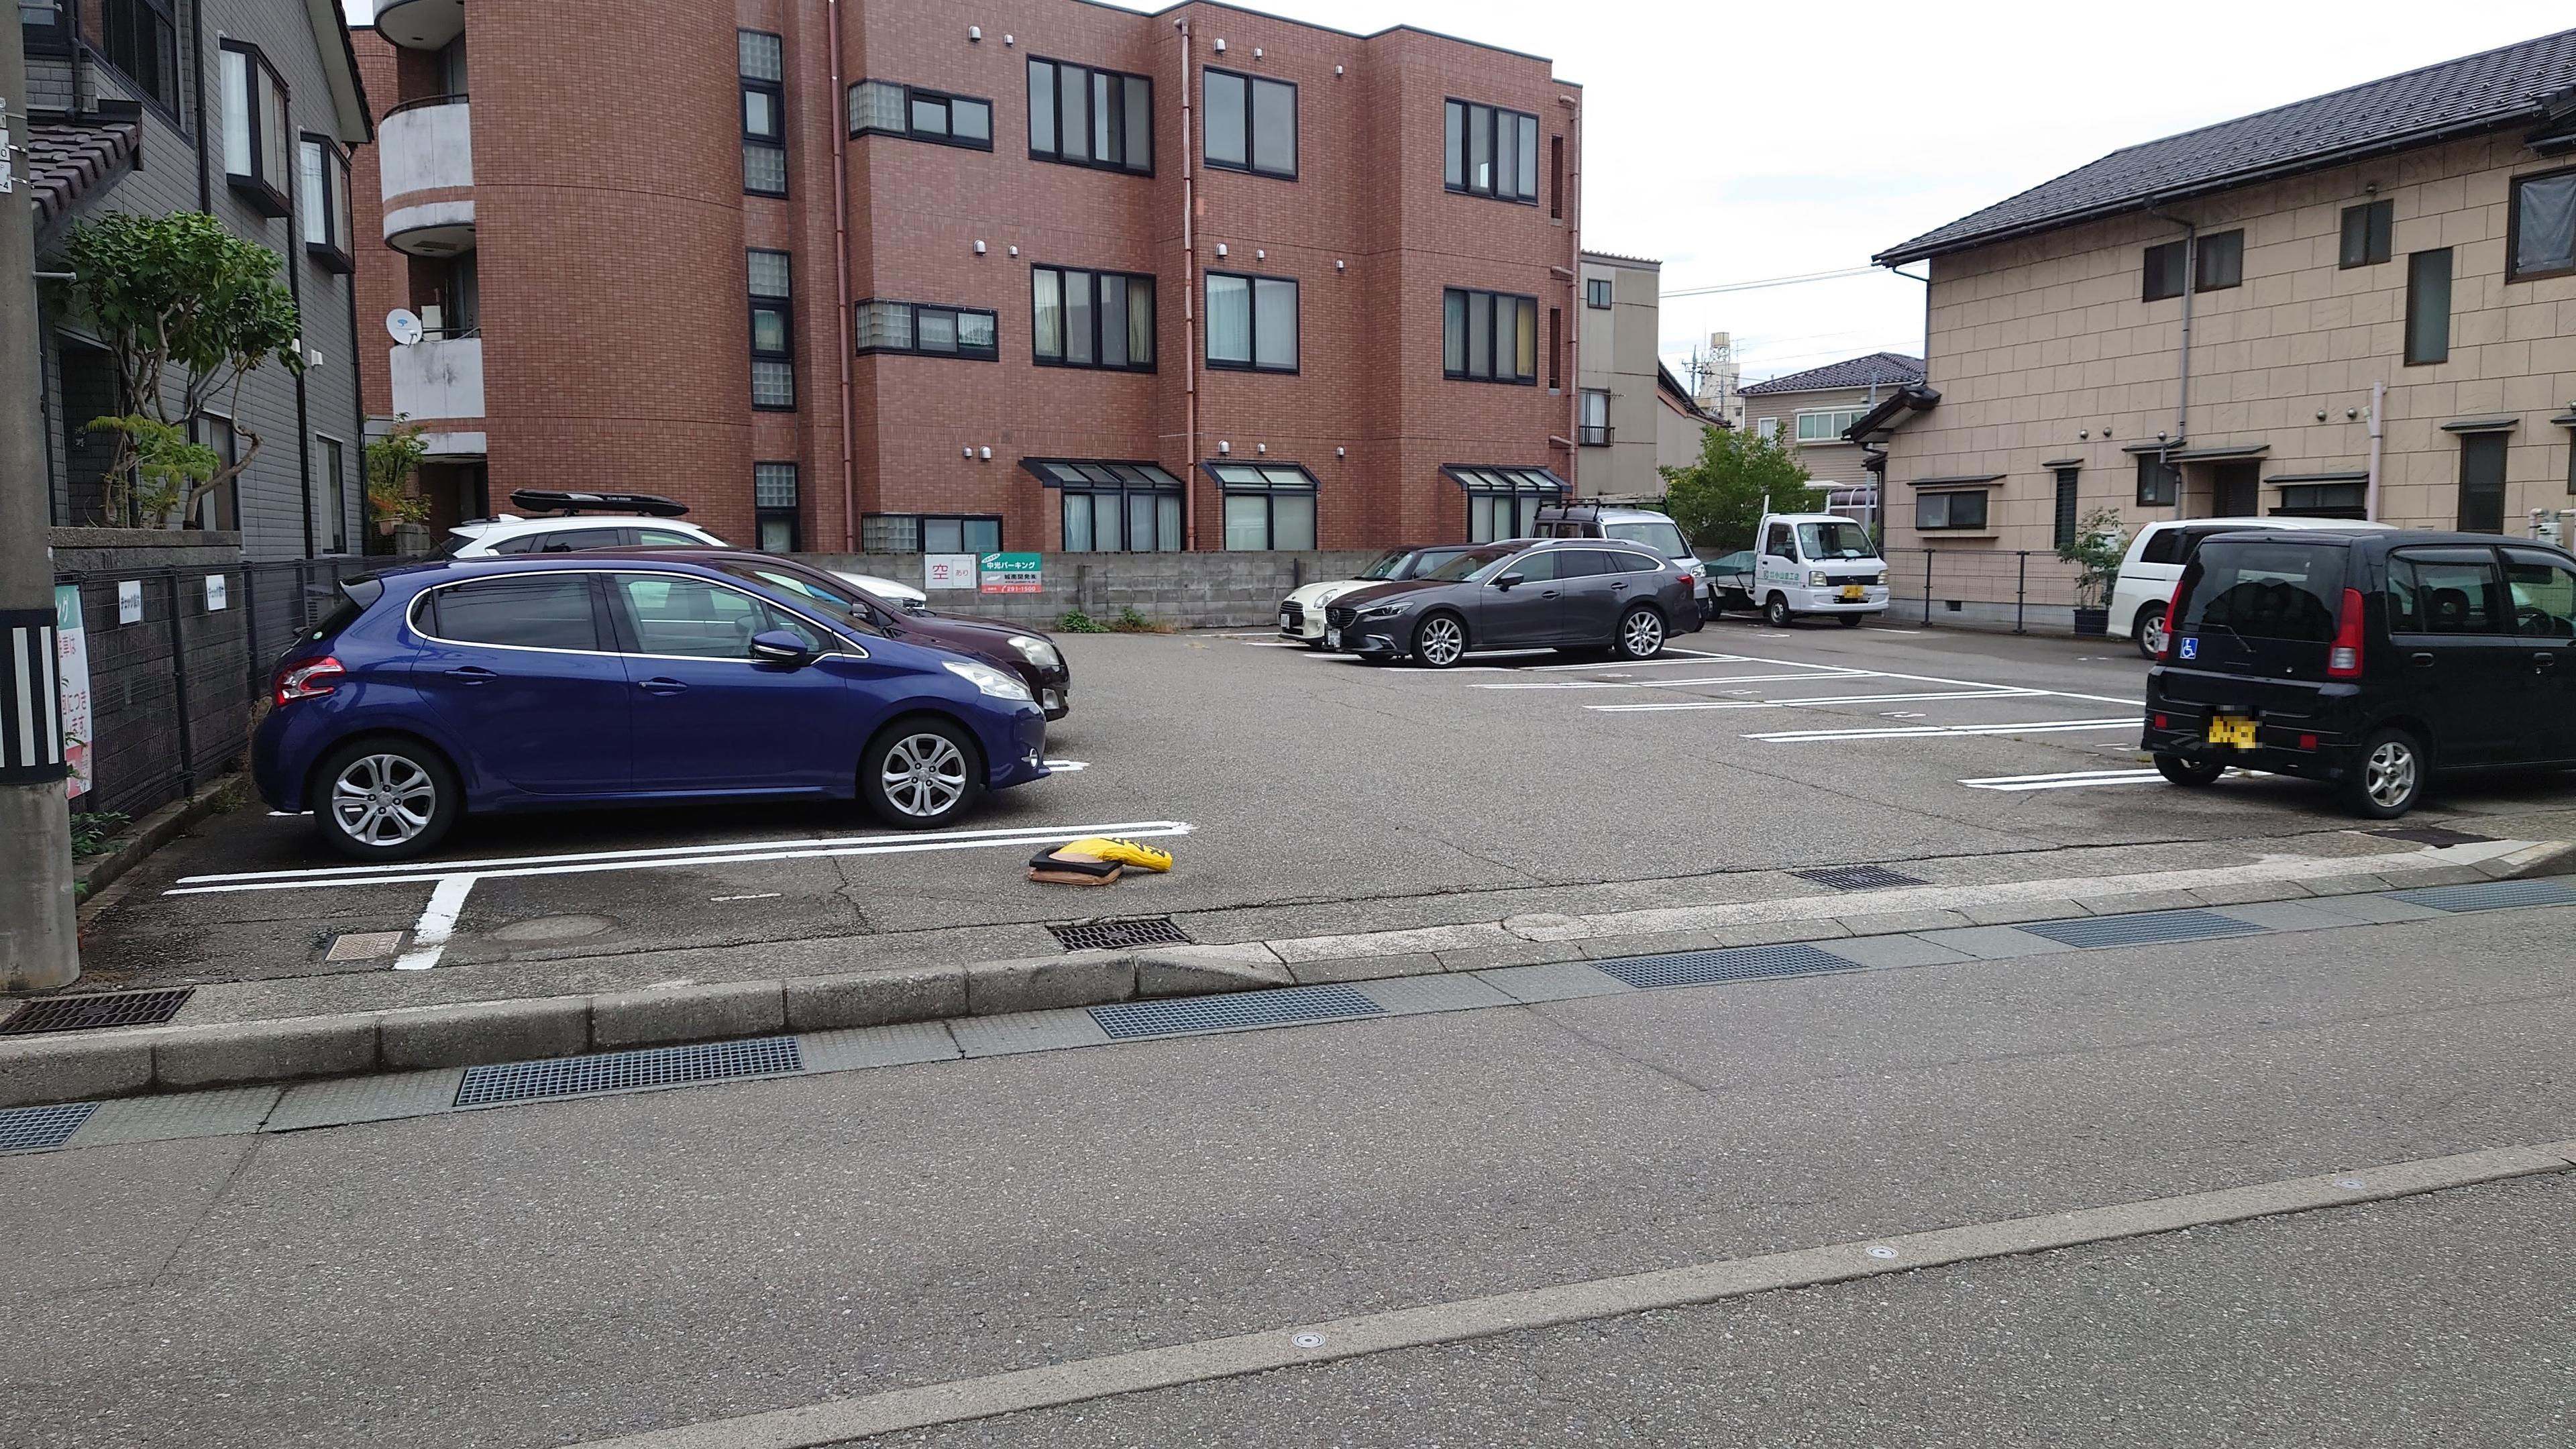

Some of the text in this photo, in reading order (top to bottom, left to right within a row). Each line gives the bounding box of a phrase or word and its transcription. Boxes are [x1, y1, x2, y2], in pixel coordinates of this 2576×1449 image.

[987, 561, 1035, 570] 中光パーキング
[932, 564, 949, 580] 空
